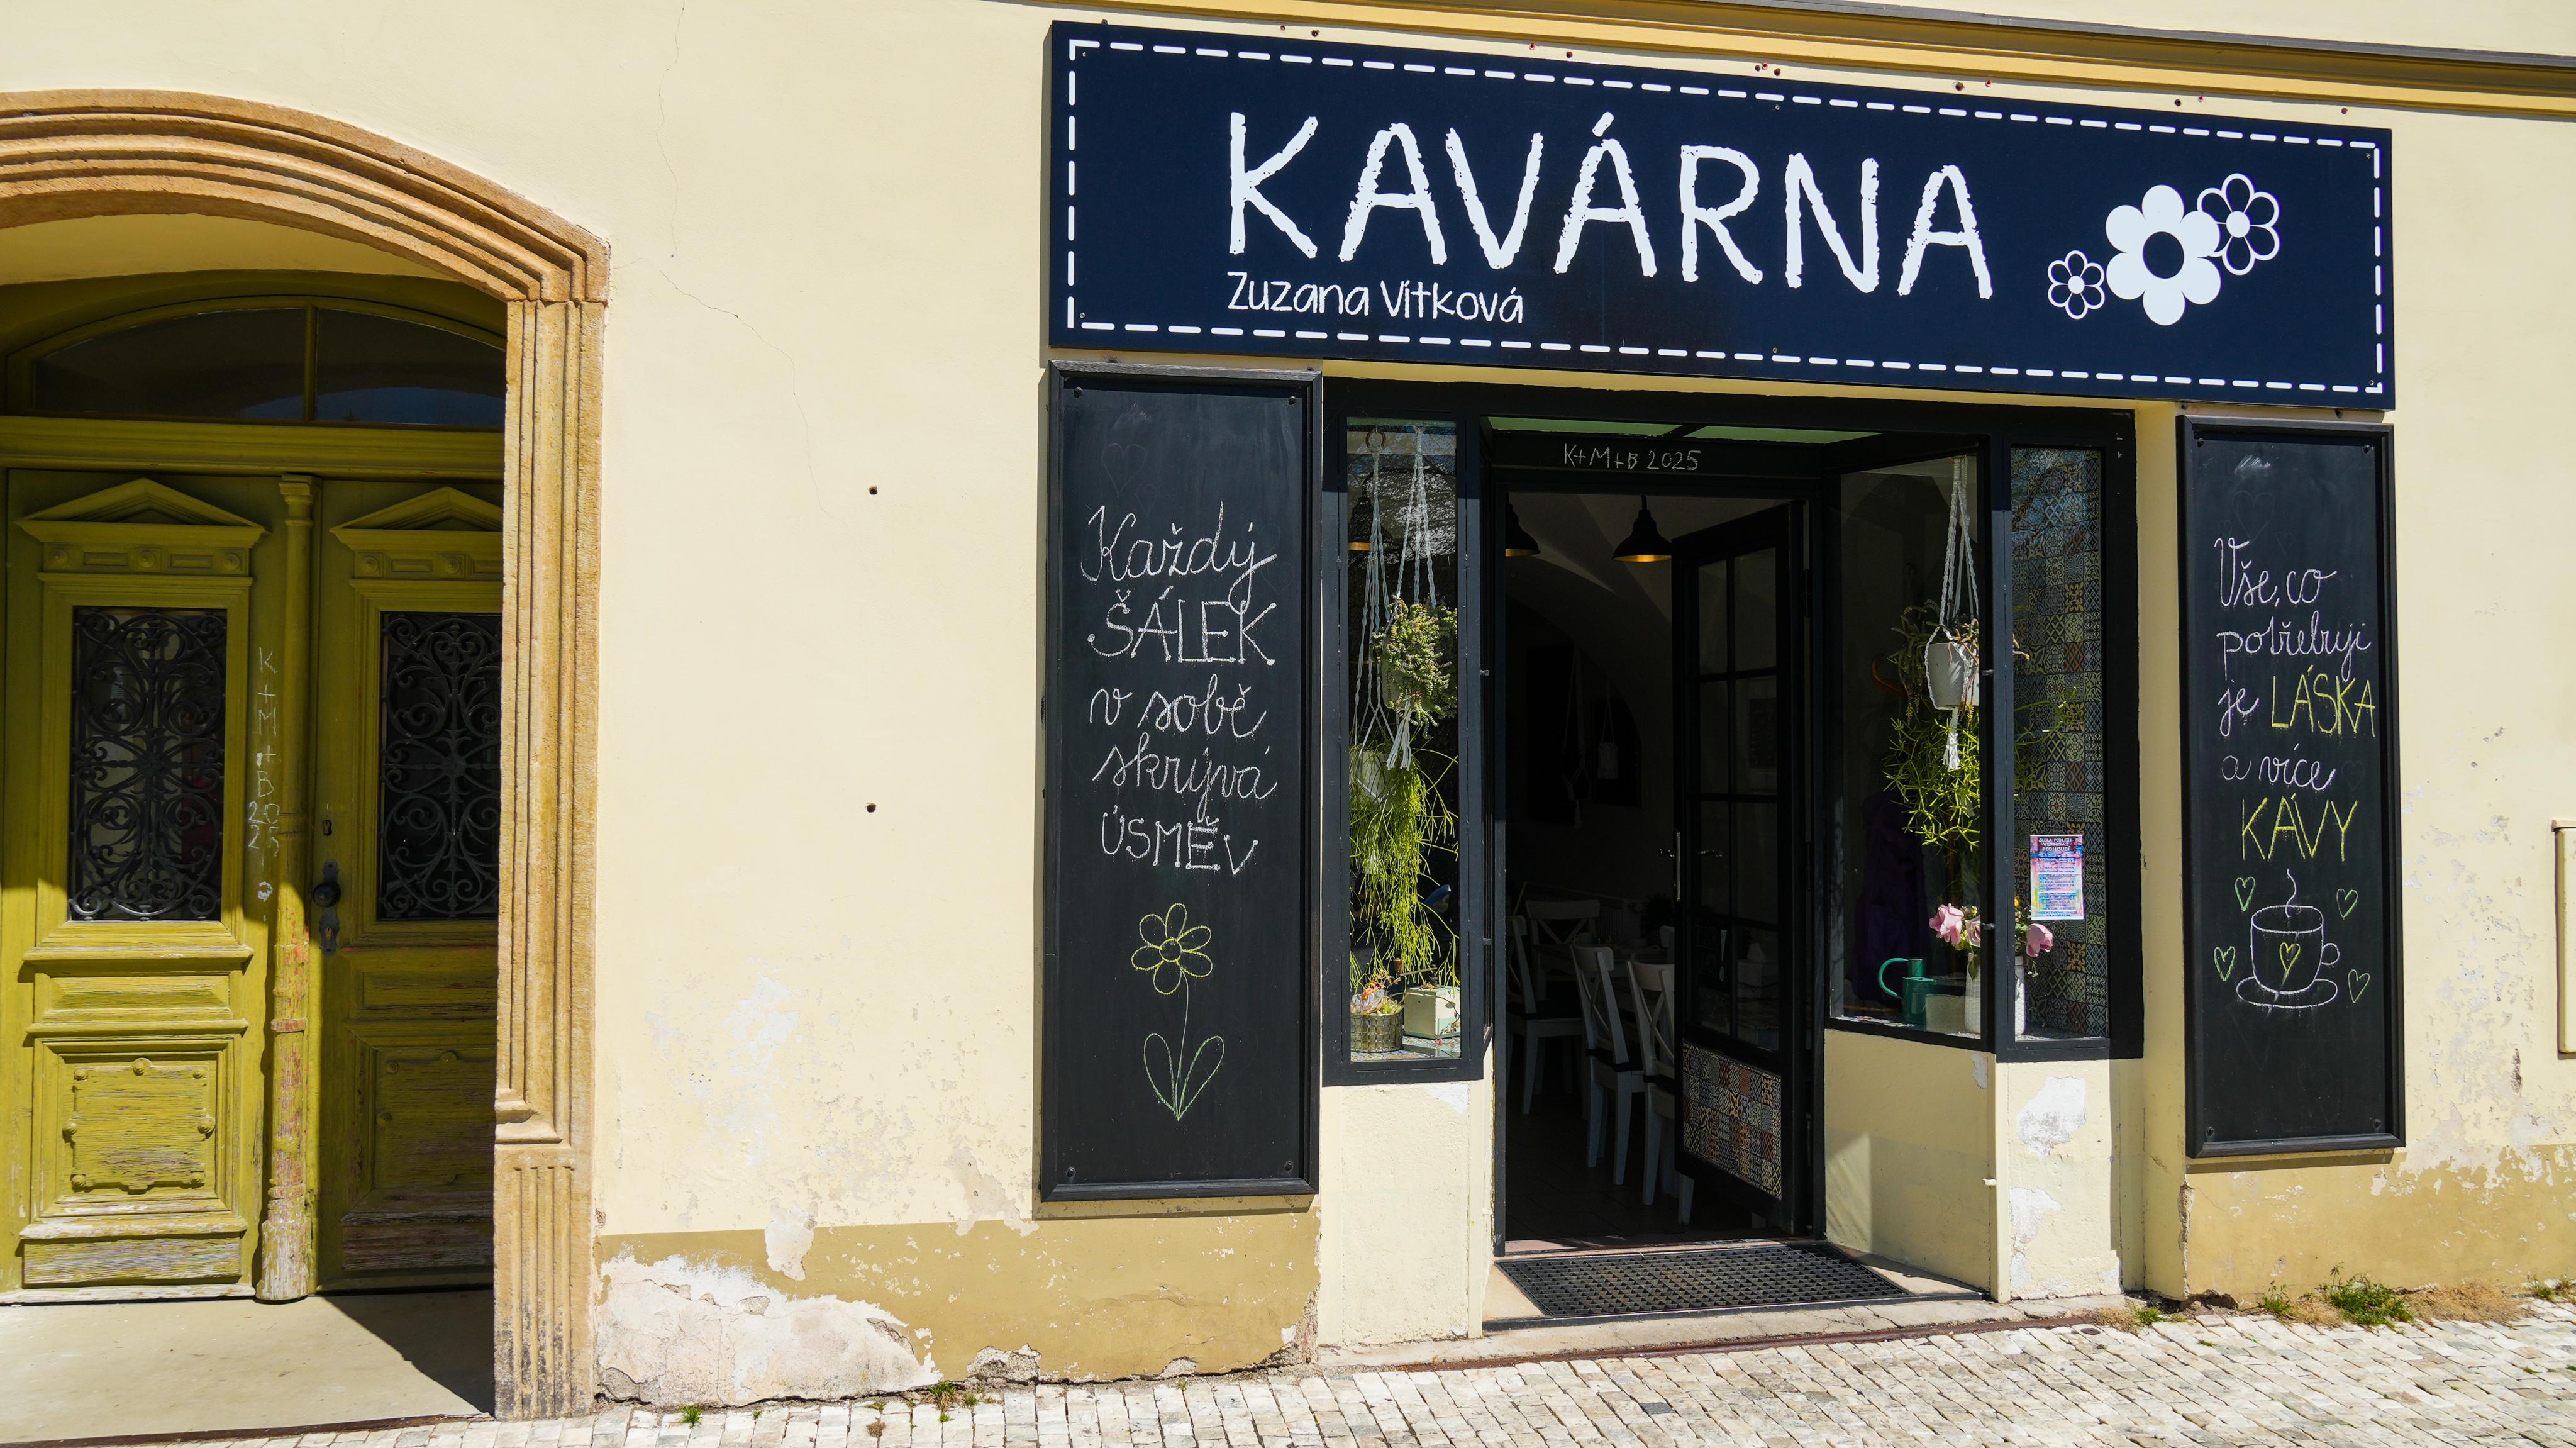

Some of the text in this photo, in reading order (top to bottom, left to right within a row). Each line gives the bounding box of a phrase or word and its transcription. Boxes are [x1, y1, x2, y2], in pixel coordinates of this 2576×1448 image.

[1228, 109, 1994, 301] KAVÁRNA
[1227, 271, 1523, 323] Zuzana Vítková
[1646, 450, 1701, 471] 2025
[1081, 501, 1277, 614] Každý
[2286, 569, 2338, 604] co
[1087, 586, 1276, 666] ŠÁLEK
[2216, 610, 2372, 682] potřebuji
[1089, 673, 1267, 738] v sobě
[2218, 664, 2375, 738] je LÁSKA
[1092, 732, 1278, 822] skrývá
[2221, 743, 2336, 791] a více
[1101, 805, 1259, 874] ÚSMĚV
[2241, 793, 2358, 862] KÁVY
